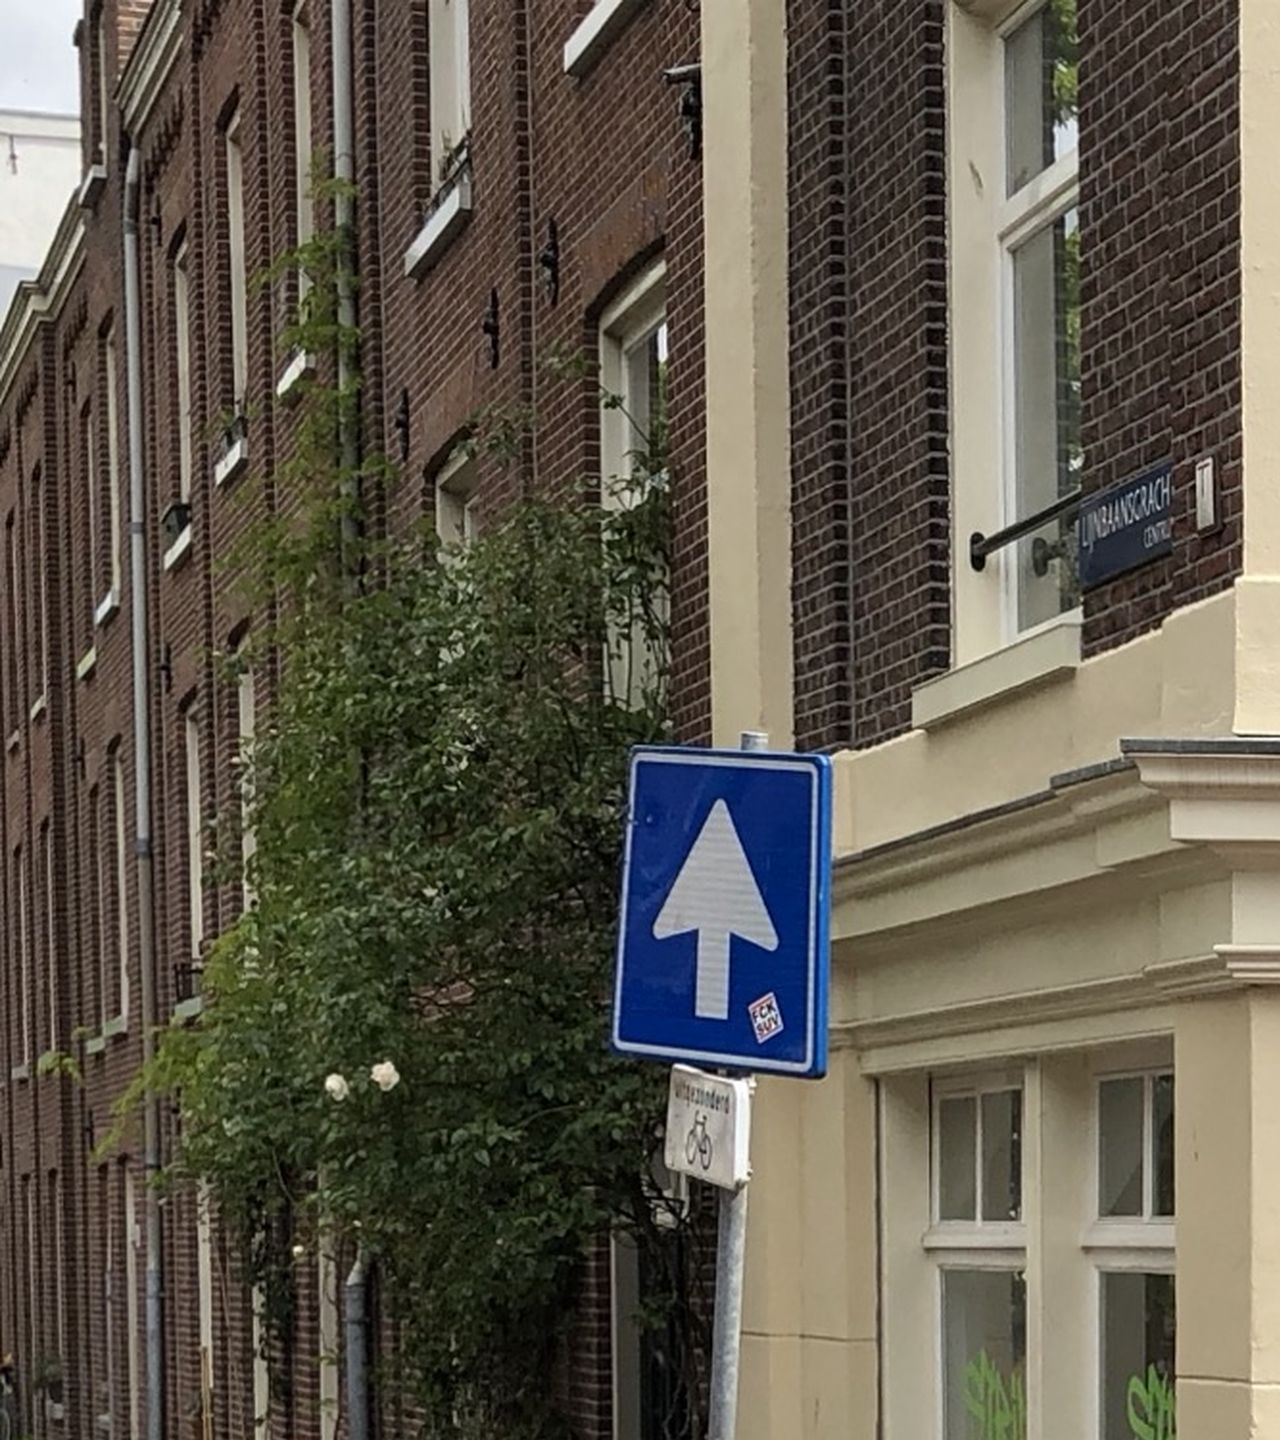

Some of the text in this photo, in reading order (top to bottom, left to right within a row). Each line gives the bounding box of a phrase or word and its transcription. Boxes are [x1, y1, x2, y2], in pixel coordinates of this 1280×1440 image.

[1081, 473, 1171, 553] LIJNBAANSGRACH
[752, 1001, 777, 1024] FCK
[756, 1013, 780, 1036] SUV
